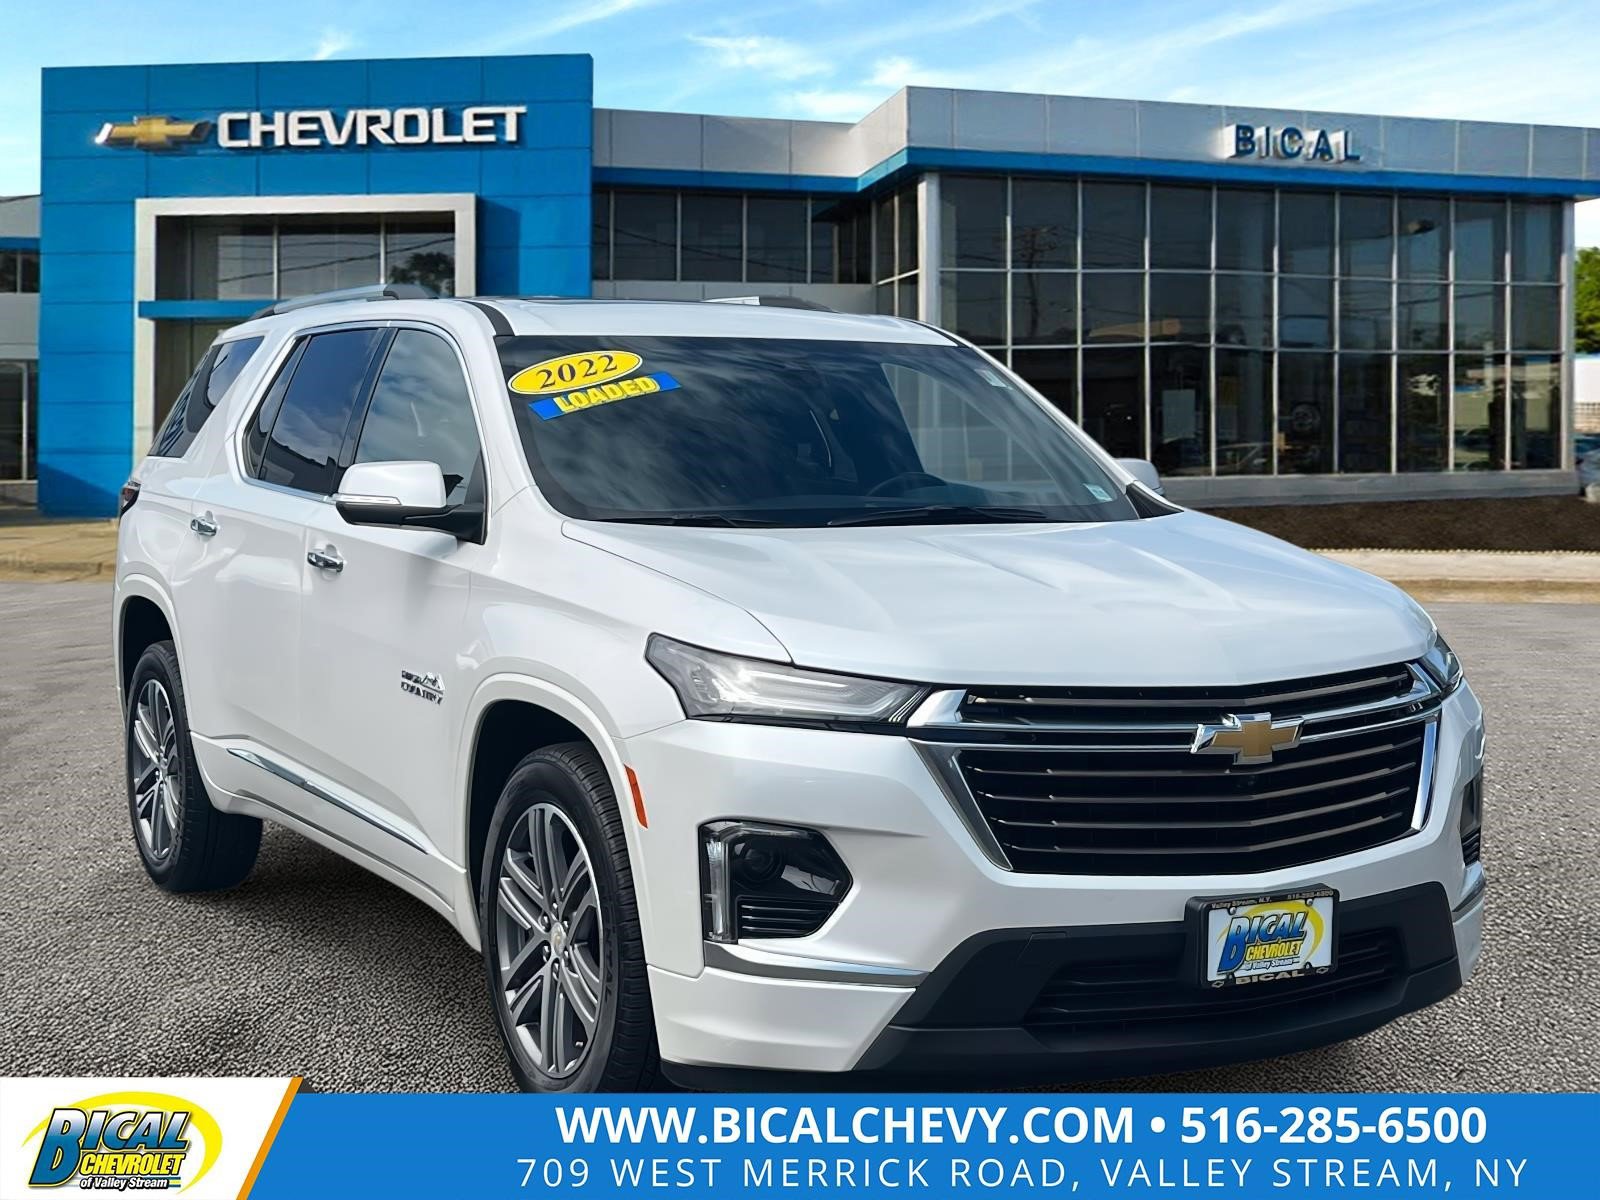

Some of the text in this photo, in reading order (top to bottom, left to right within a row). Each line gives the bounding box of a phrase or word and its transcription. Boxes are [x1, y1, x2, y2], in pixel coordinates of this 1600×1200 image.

[218, 105, 527, 149] CHEVROLET
[1232, 123, 1361, 161] BICAL
[535, 353, 618, 390] 2022
[553, 376, 661, 414] LOADED
[1217, 911, 1309, 975] BICAL
[1245, 940, 1304, 961] CHEVROLET
[1235, 970, 1305, 985] BICAL
